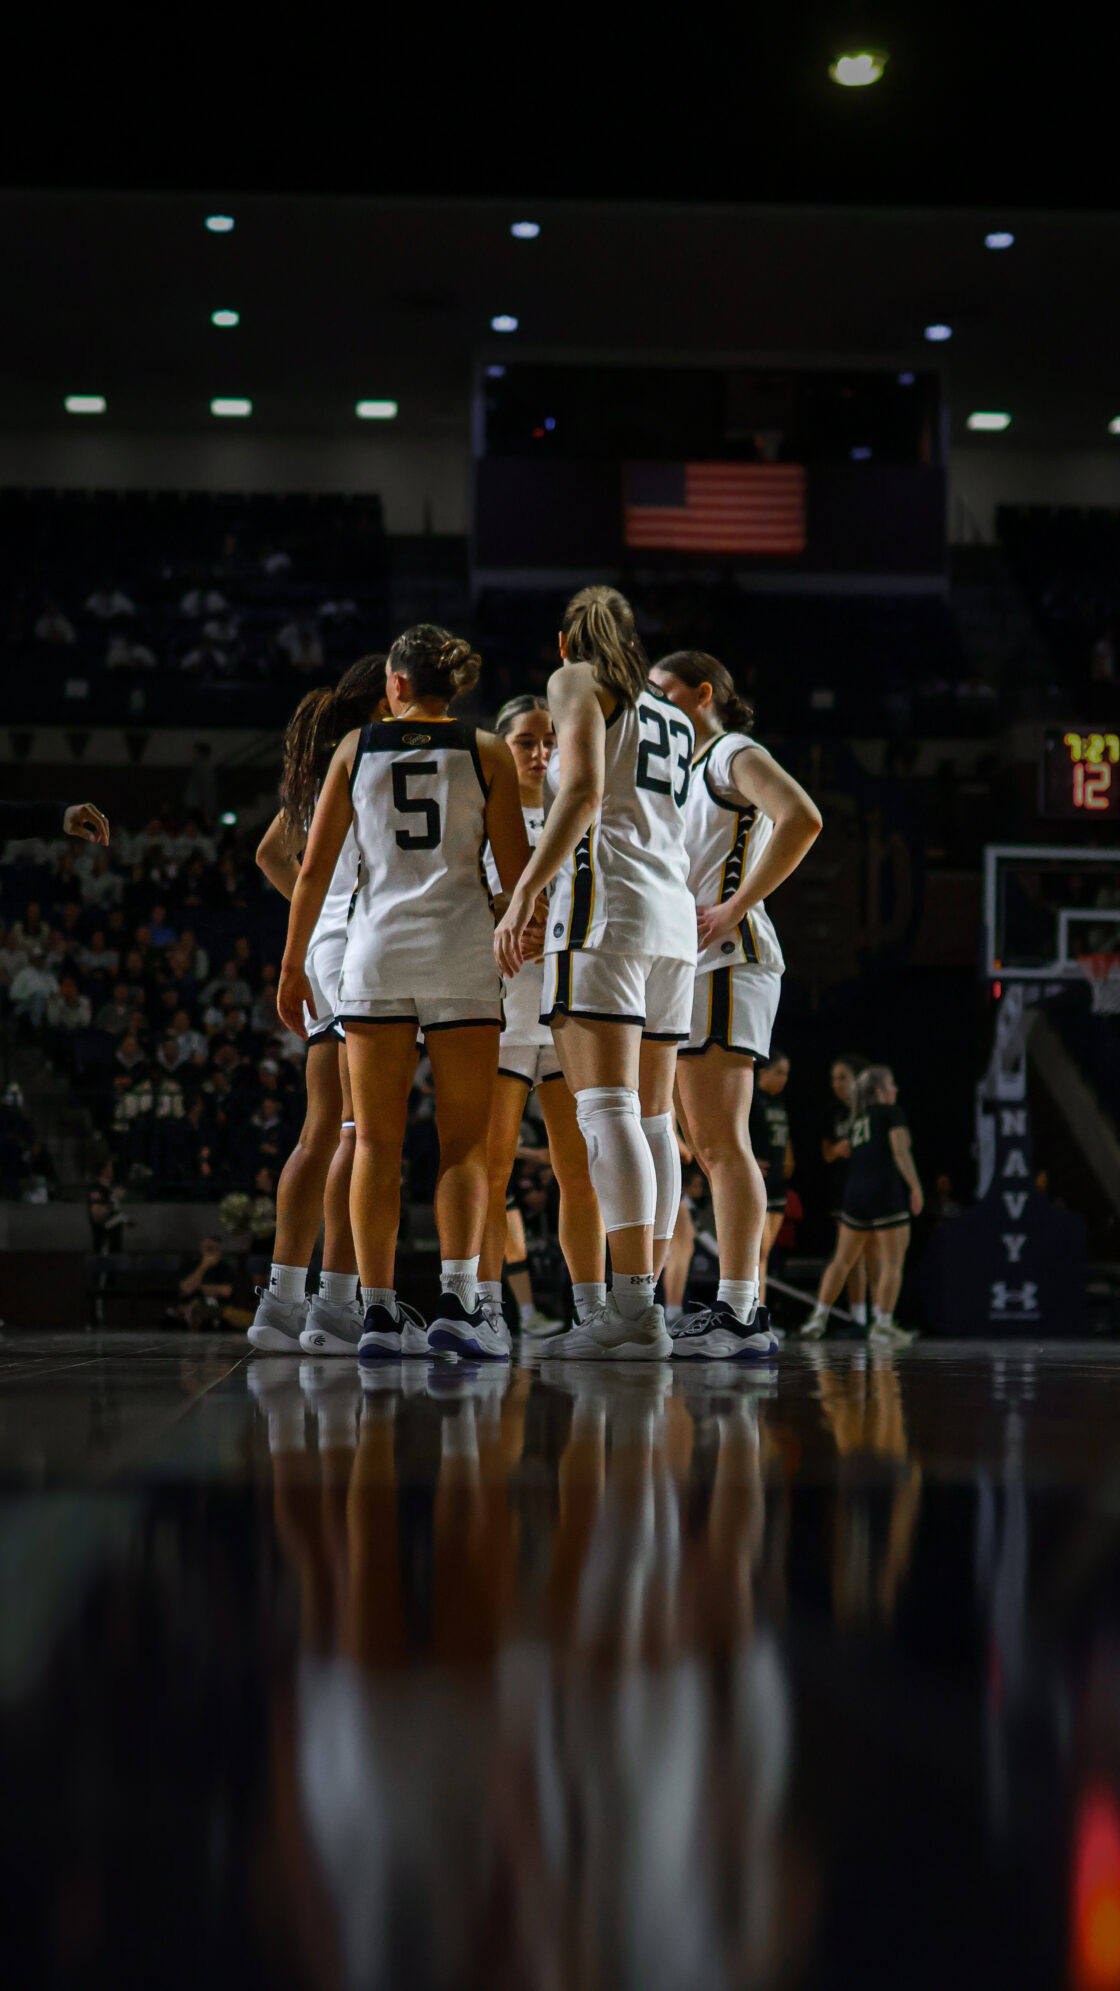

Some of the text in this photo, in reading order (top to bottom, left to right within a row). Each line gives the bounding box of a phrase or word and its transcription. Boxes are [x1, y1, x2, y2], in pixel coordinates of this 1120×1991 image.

[637, 704, 692, 808] 23
[1064, 733, 1120, 763] 7:27
[1073, 762, 1111, 809] 12
[392, 761, 441, 850] 5
[1001, 1107, 1030, 1263] NAVY
